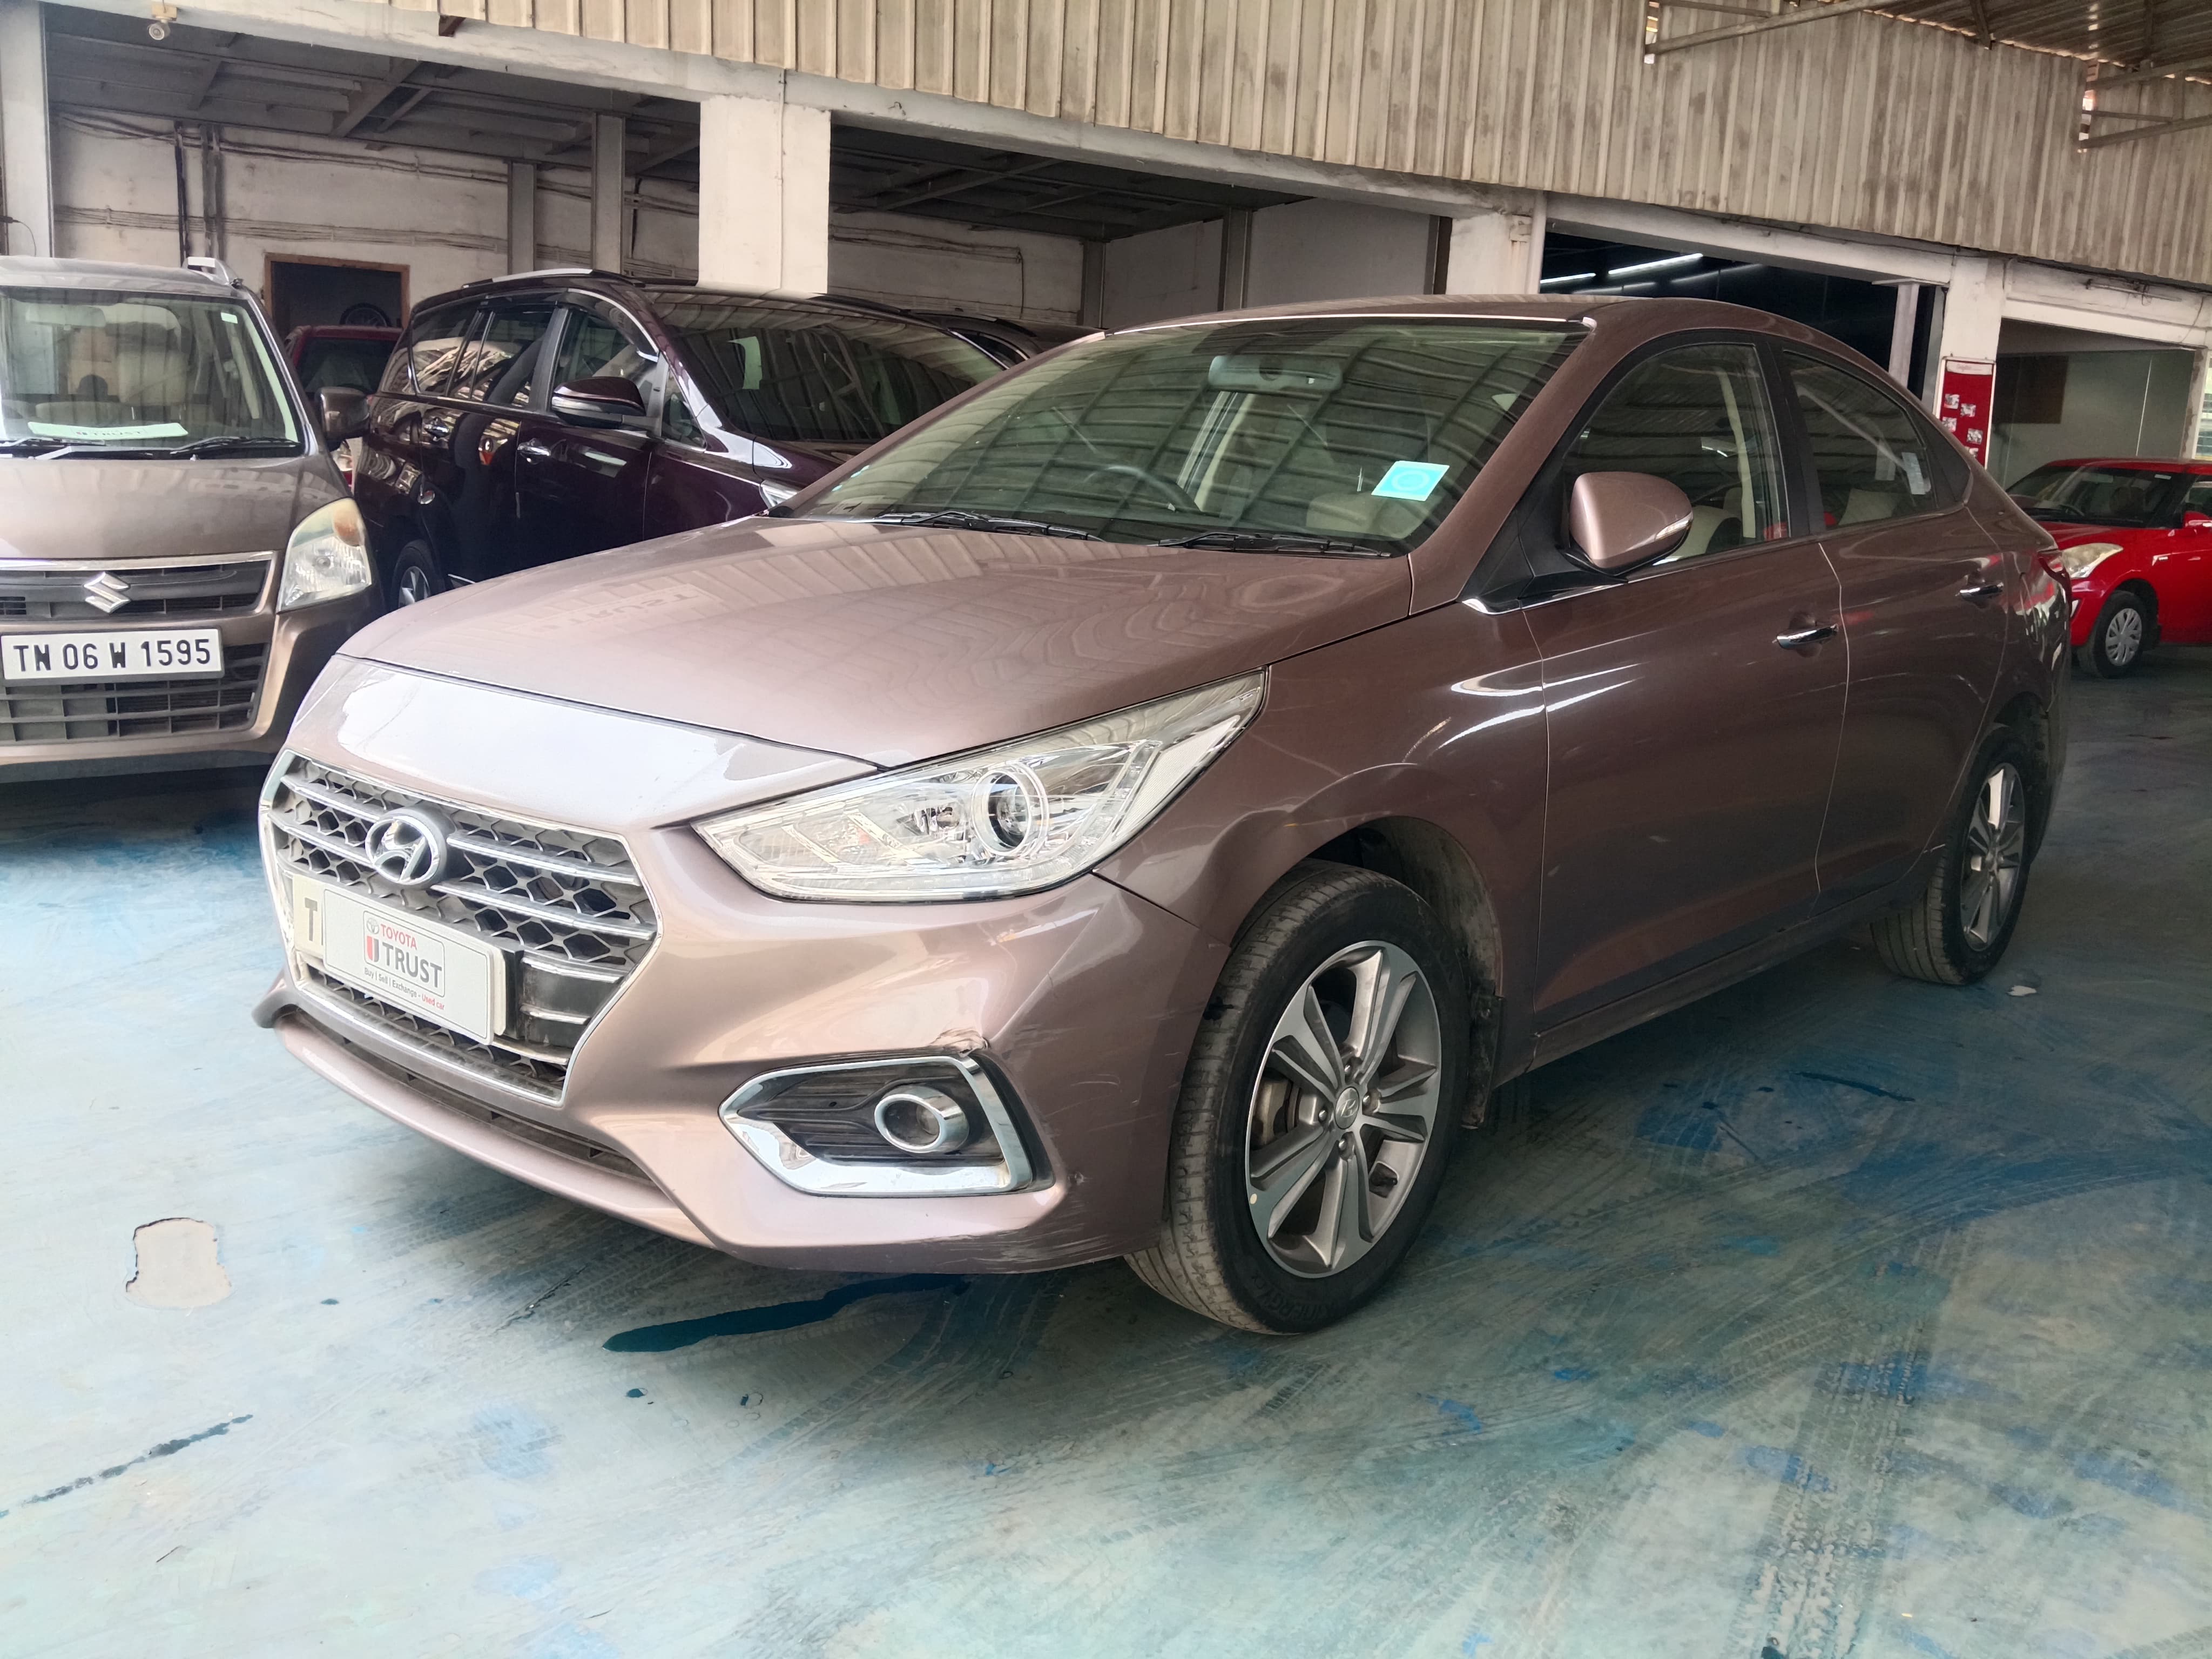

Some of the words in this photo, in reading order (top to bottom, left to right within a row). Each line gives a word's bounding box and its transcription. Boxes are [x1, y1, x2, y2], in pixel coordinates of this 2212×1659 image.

[14, 644, 51, 672] TN
[62, 643, 98, 670] 06
[109, 642, 126, 668] W
[140, 639, 211, 667] 1595
[380, 923, 417, 950] TOYOTA
[382, 941, 442, 988] TRUST
[365, 967, 374, 979] Buy
[378, 973, 388, 985] Sell
[392, 980, 417, 997] Exchange
[421, 994, 435, 1007] Used
[436, 1001, 445, 1010] car
